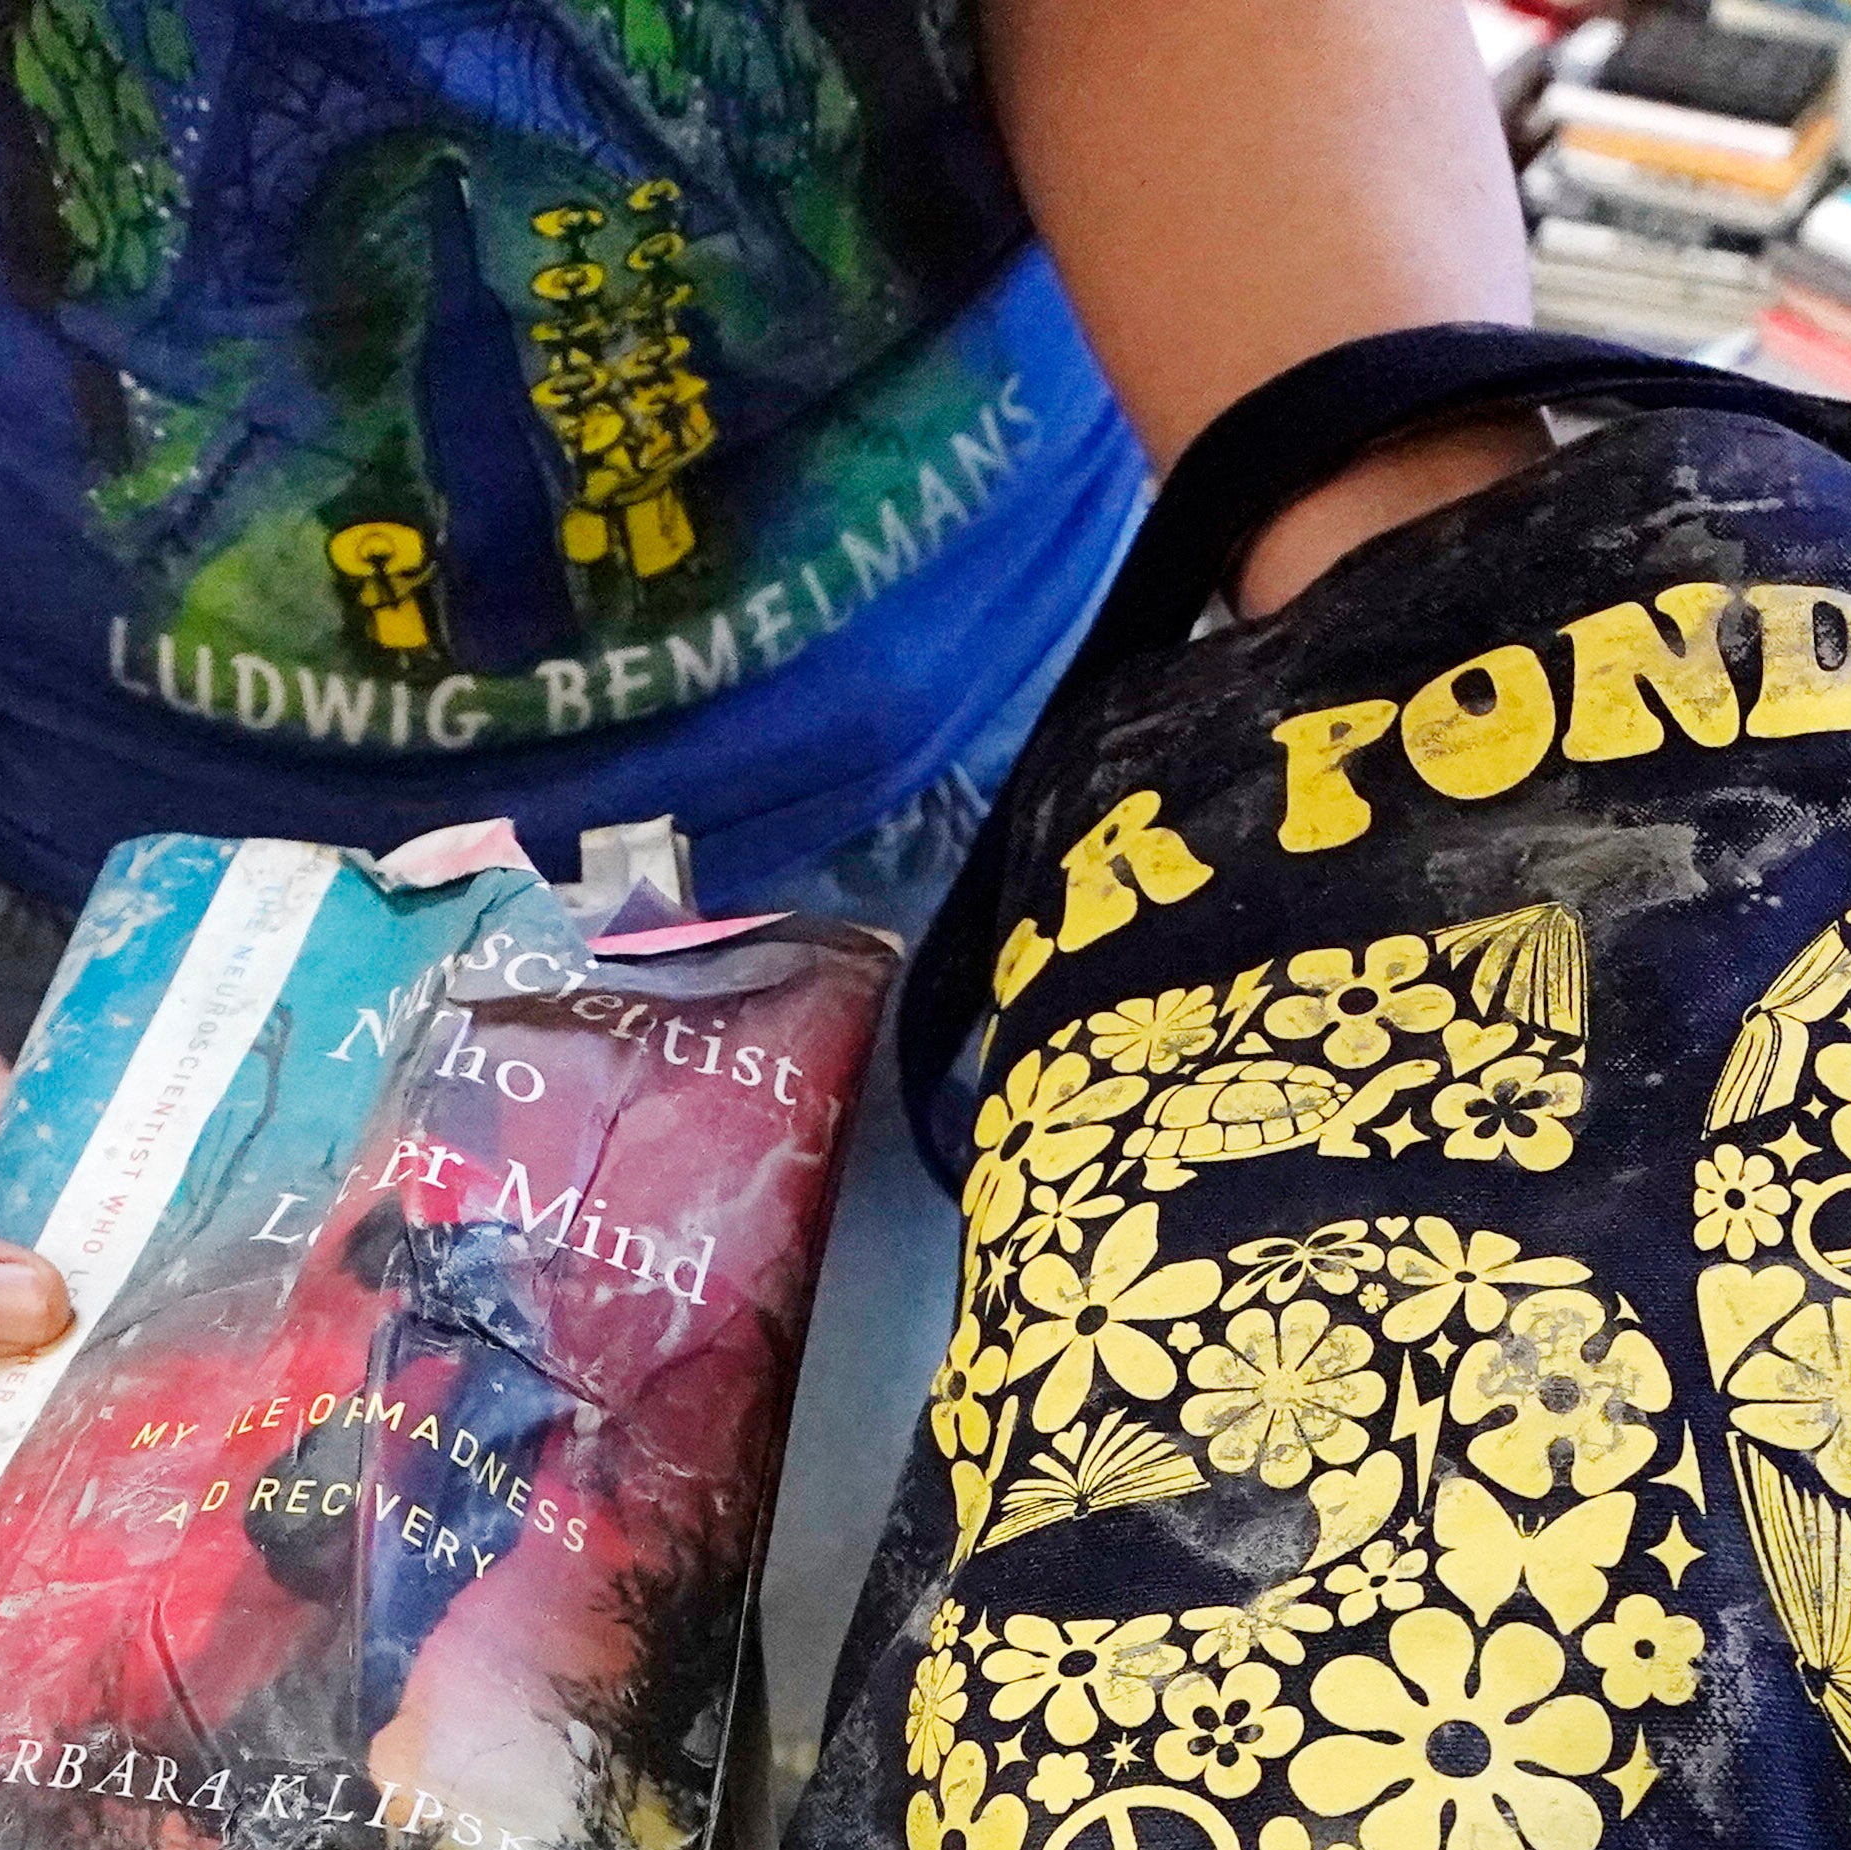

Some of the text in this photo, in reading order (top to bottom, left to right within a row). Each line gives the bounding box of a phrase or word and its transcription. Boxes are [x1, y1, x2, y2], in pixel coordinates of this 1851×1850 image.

[107, 373, 1041, 750] LUDWIG BEMELMANS
[113, 945, 255, 1180] NEUROSCIENTIST
[432, 1006, 547, 1104] ho
[82, 1194, 128, 1256] WHO
[484, 1158, 716, 1305] Mind
[131, 1421, 199, 1450] MY
[364, 1391, 589, 1554] MADNESS
[154, 1477, 496, 1579] AD RECVERY
